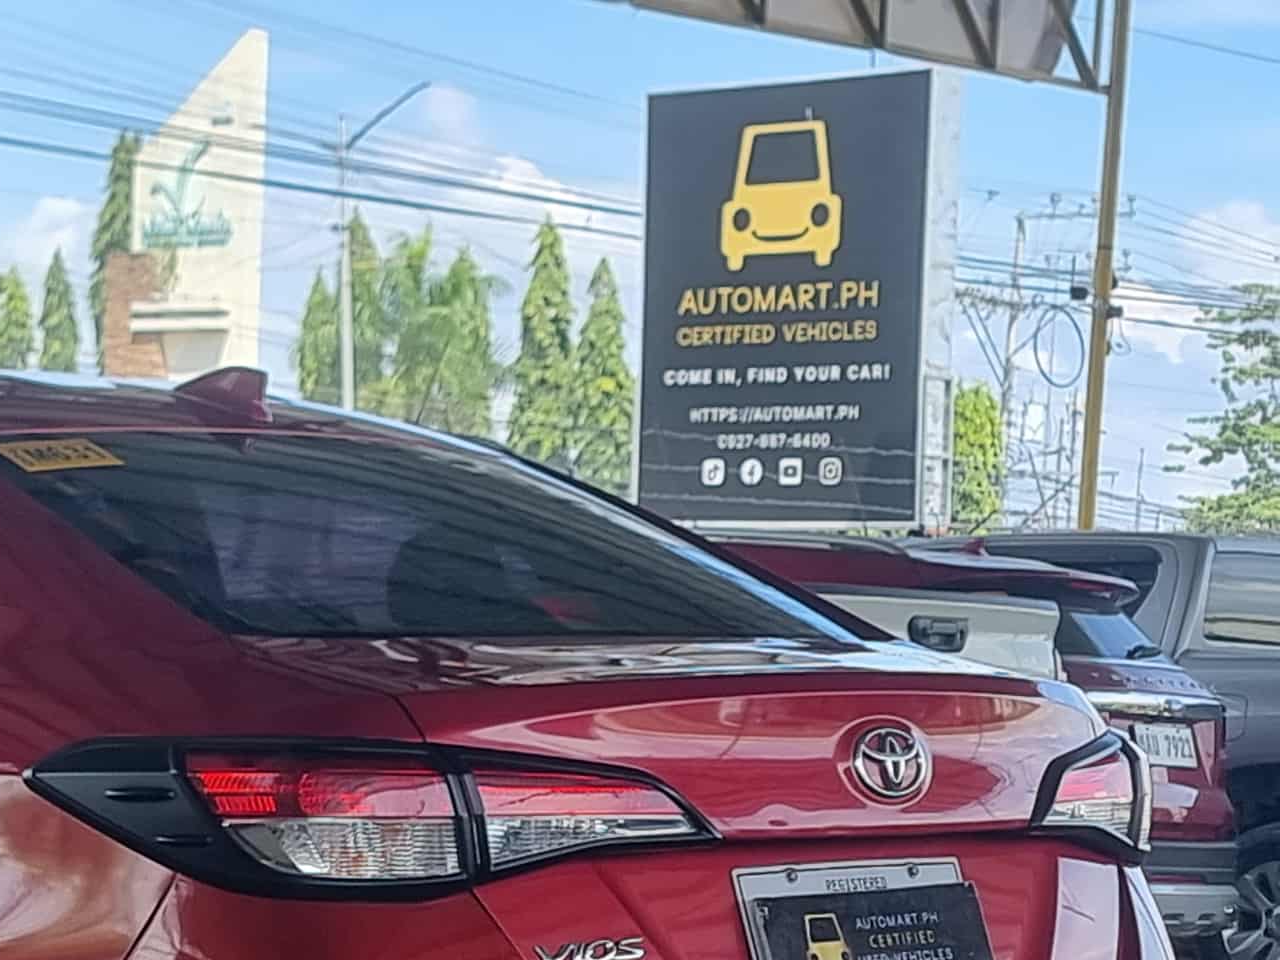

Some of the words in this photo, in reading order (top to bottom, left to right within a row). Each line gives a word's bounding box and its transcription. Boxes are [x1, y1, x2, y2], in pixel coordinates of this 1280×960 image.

[677, 279, 880, 315] AUTOMART.PH
[676, 324, 776, 346] CERTIFIED
[782, 320, 878, 342] VEHICLES
[663, 368, 712, 386] COME
[716, 368, 742, 387] IN,
[746, 367, 788, 384] FIND
[793, 365, 841, 382] YOUR
[846, 363, 891, 381] CAR!
[689, 404, 860, 424] HTTPS://AUTOMART.PH
[825, 876, 888, 891] REGISTERED
[855, 911, 939, 930] AUTOMART.PH
[869, 930, 935, 948] CERTIFIED
